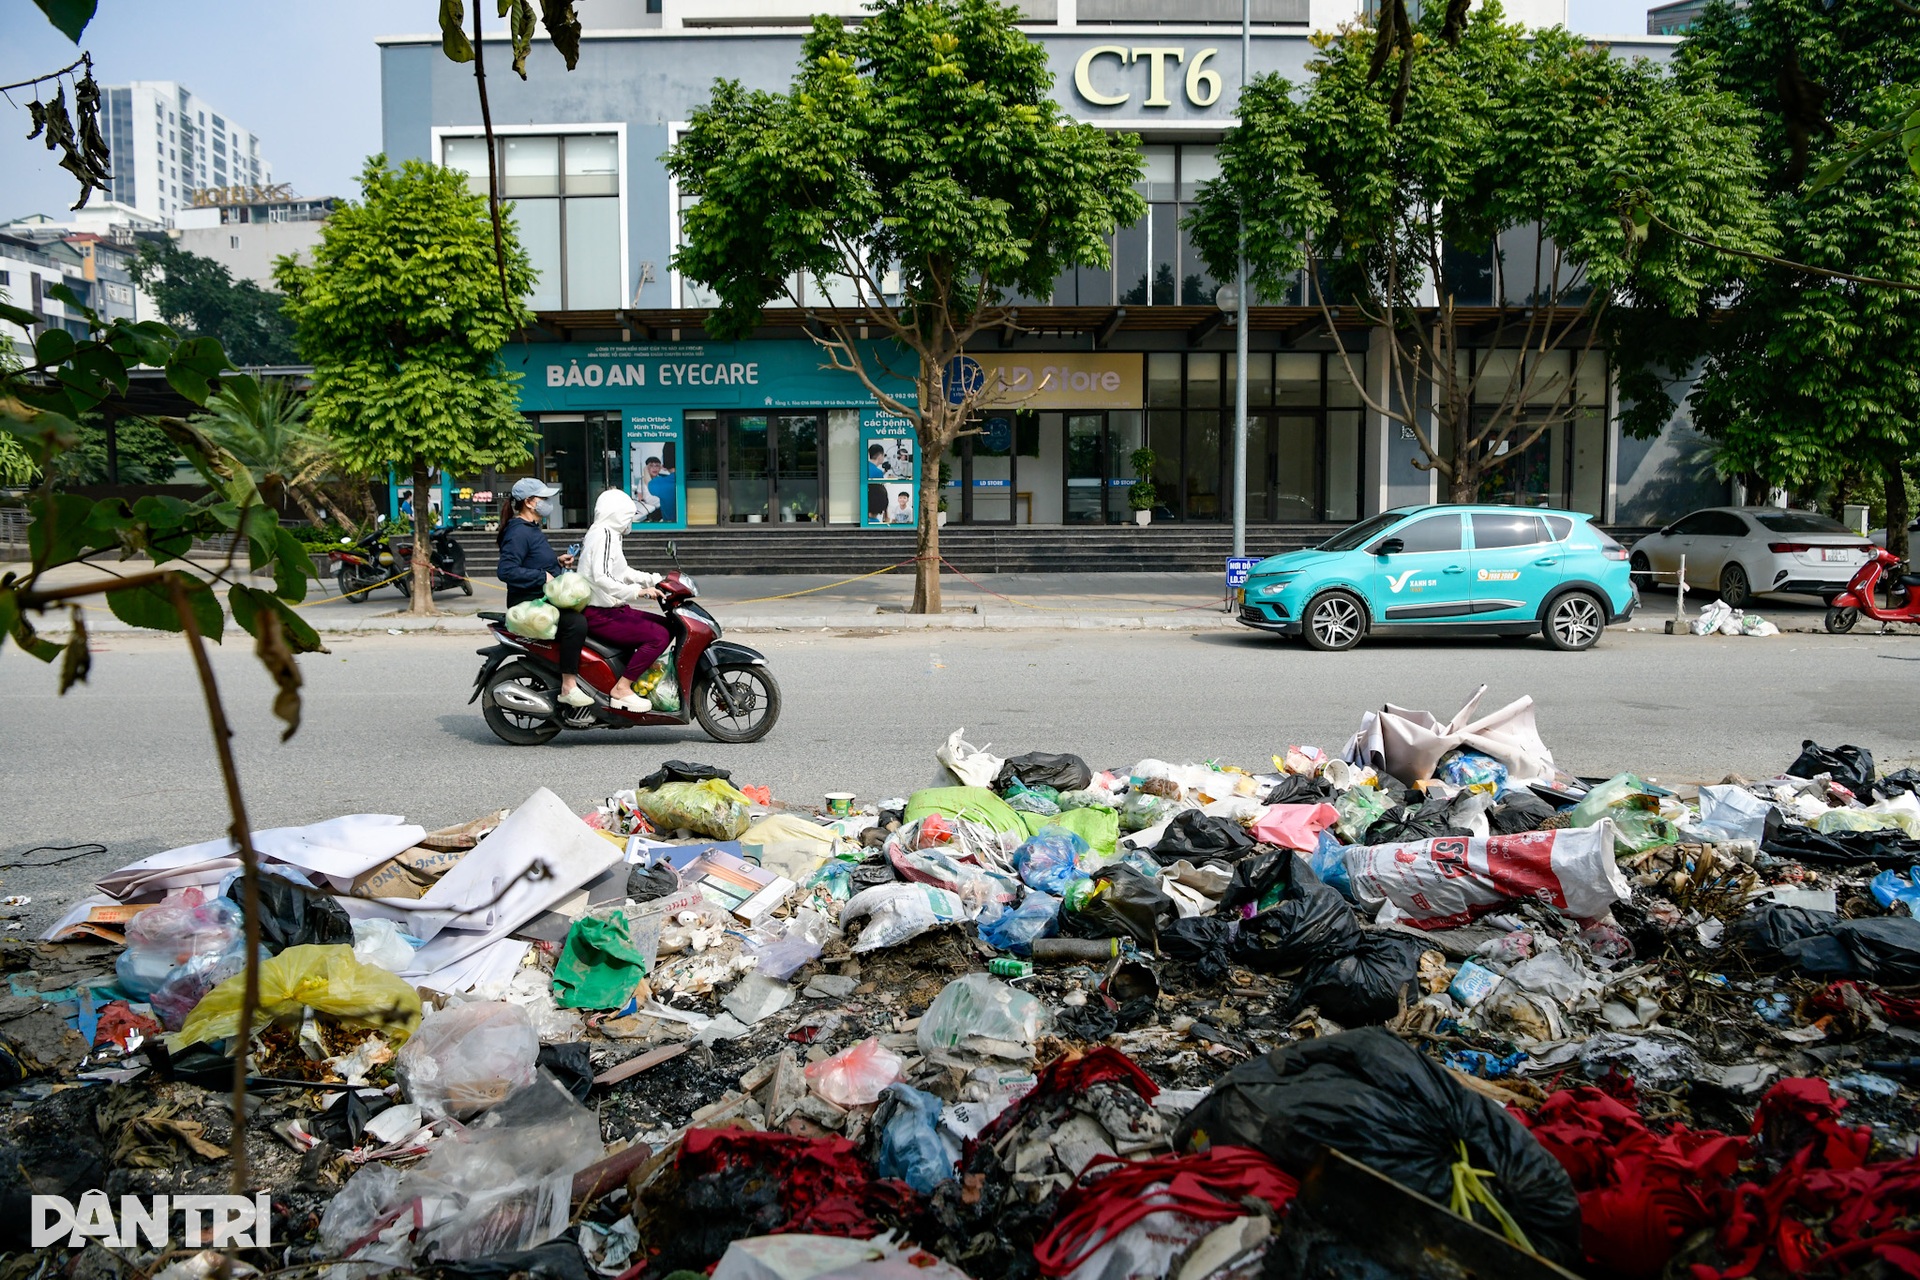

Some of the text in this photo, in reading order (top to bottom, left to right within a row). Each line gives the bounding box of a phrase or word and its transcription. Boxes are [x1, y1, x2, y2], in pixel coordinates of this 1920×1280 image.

[1075, 45, 1222, 107] CT6
[192, 186, 250, 207] HOTEL
[546, 360, 759, 387] BẢO AN EYECARE
[998, 366, 1121, 392] LD Store
[863, 419, 881, 427] các
[882, 419, 906, 428] bệnh
[658, 430, 678, 439] Trang
[1409, 579, 1427, 587] XANH
